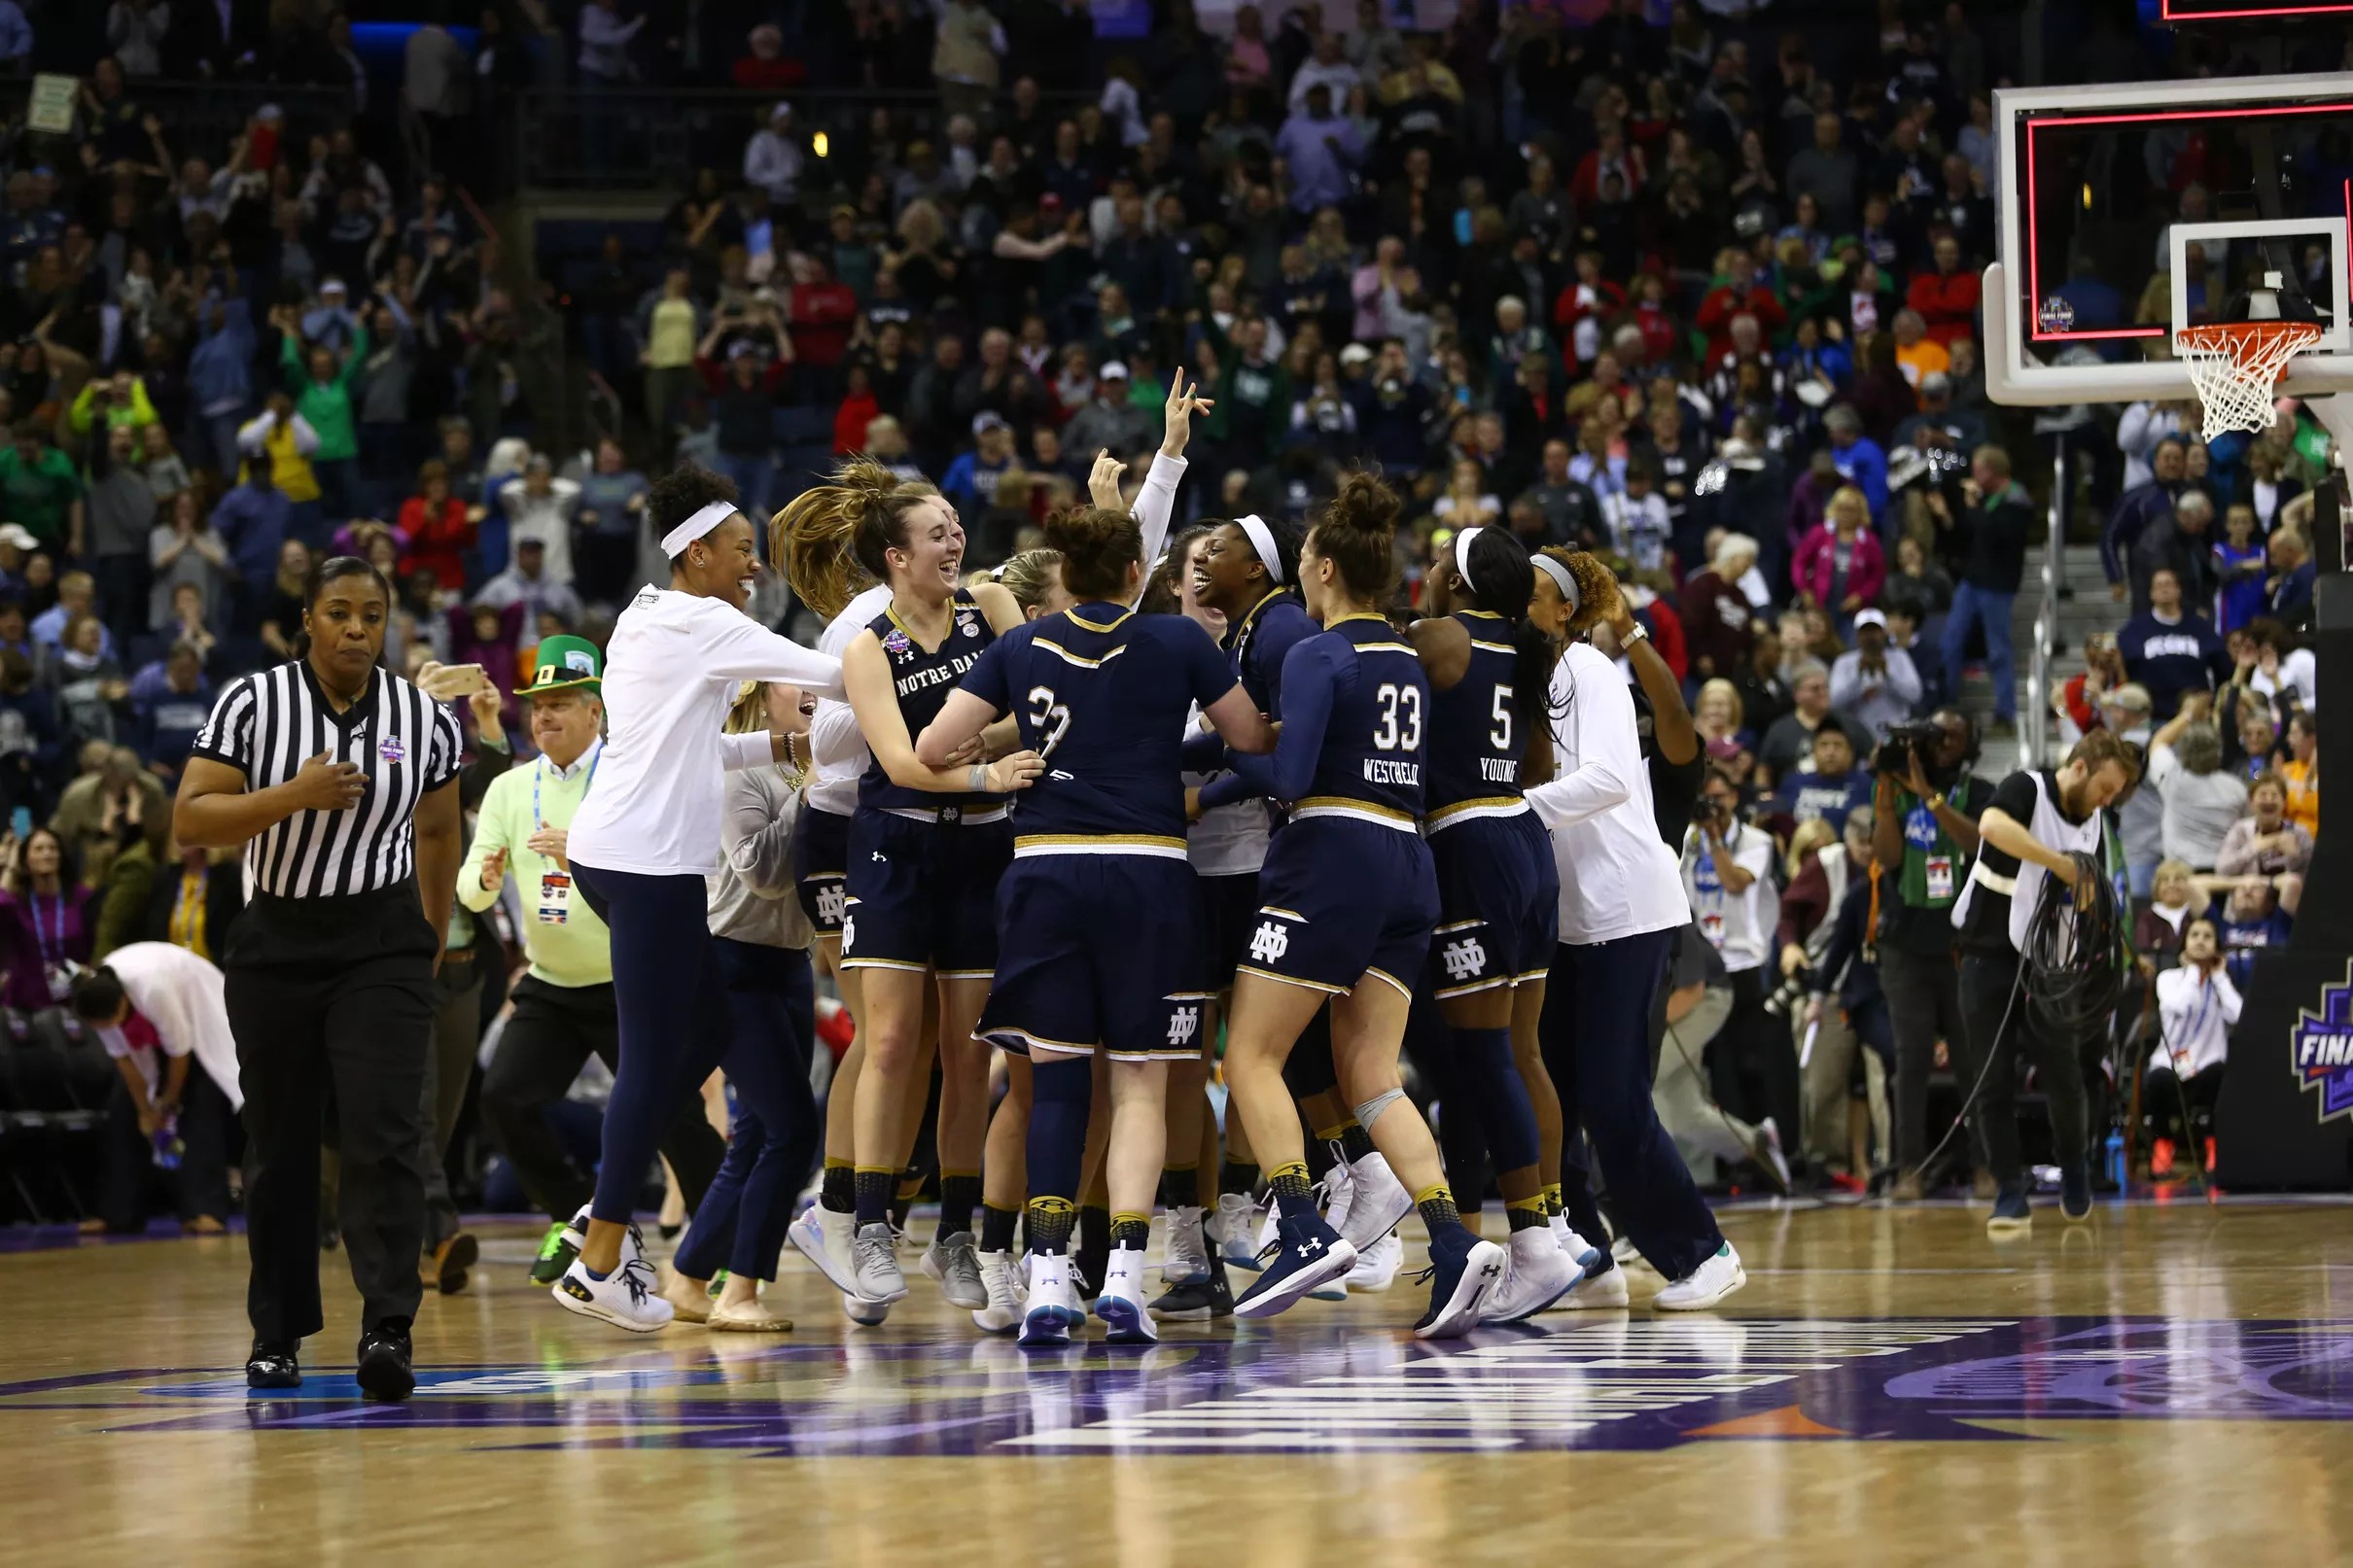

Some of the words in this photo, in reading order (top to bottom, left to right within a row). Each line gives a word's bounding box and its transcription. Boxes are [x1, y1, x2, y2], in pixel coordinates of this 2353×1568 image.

[896, 666, 952, 697] NOTRE
[1374, 683, 1422, 751] 33
[1491, 682, 1513, 750] 5
[1364, 757, 1420, 786] WESTBELD
[1480, 757, 1518, 783] YOUNG
